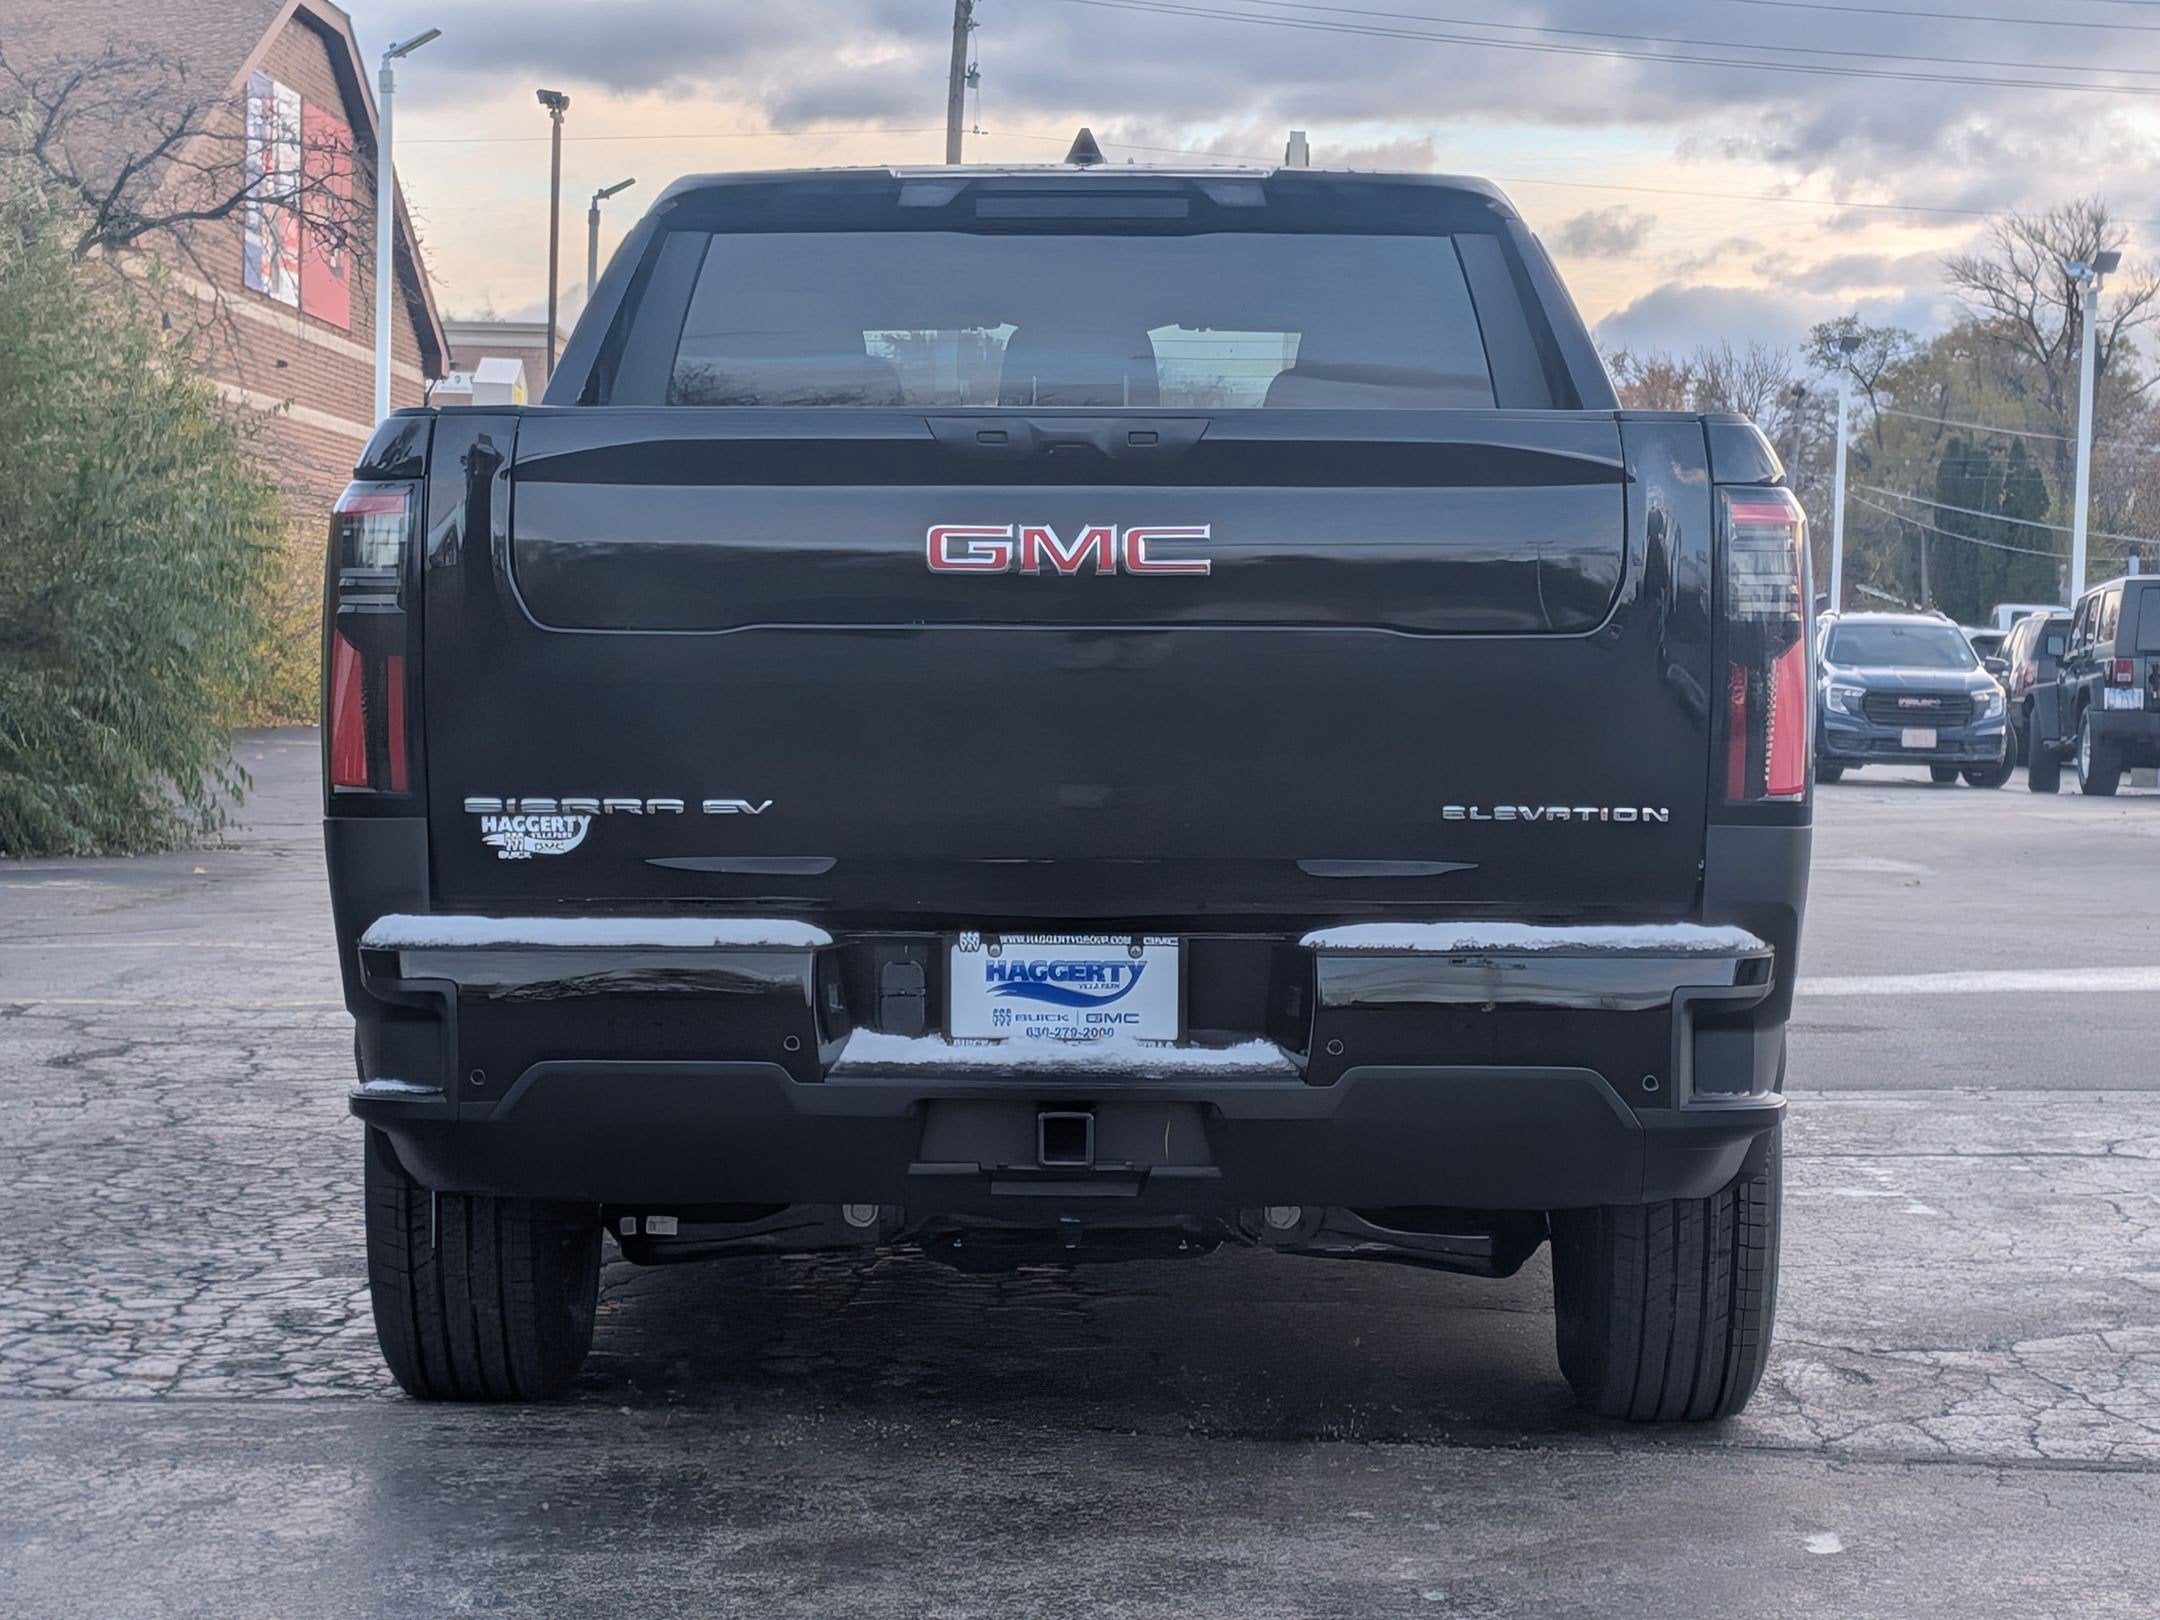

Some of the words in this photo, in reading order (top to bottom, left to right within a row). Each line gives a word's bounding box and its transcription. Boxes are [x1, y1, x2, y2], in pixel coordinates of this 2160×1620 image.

[927, 524, 1211, 576] GMC
[464, 797, 685, 815] SIERRA
[703, 799, 773, 814] EV
[1442, 805, 1669, 822] ELEVATION
[481, 815, 591, 833] HAGGERTY
[985, 960, 1147, 983] HAGGERTY
[1015, 1014, 1070, 1022] BUICK
[1086, 1013, 1140, 1024] GMC
